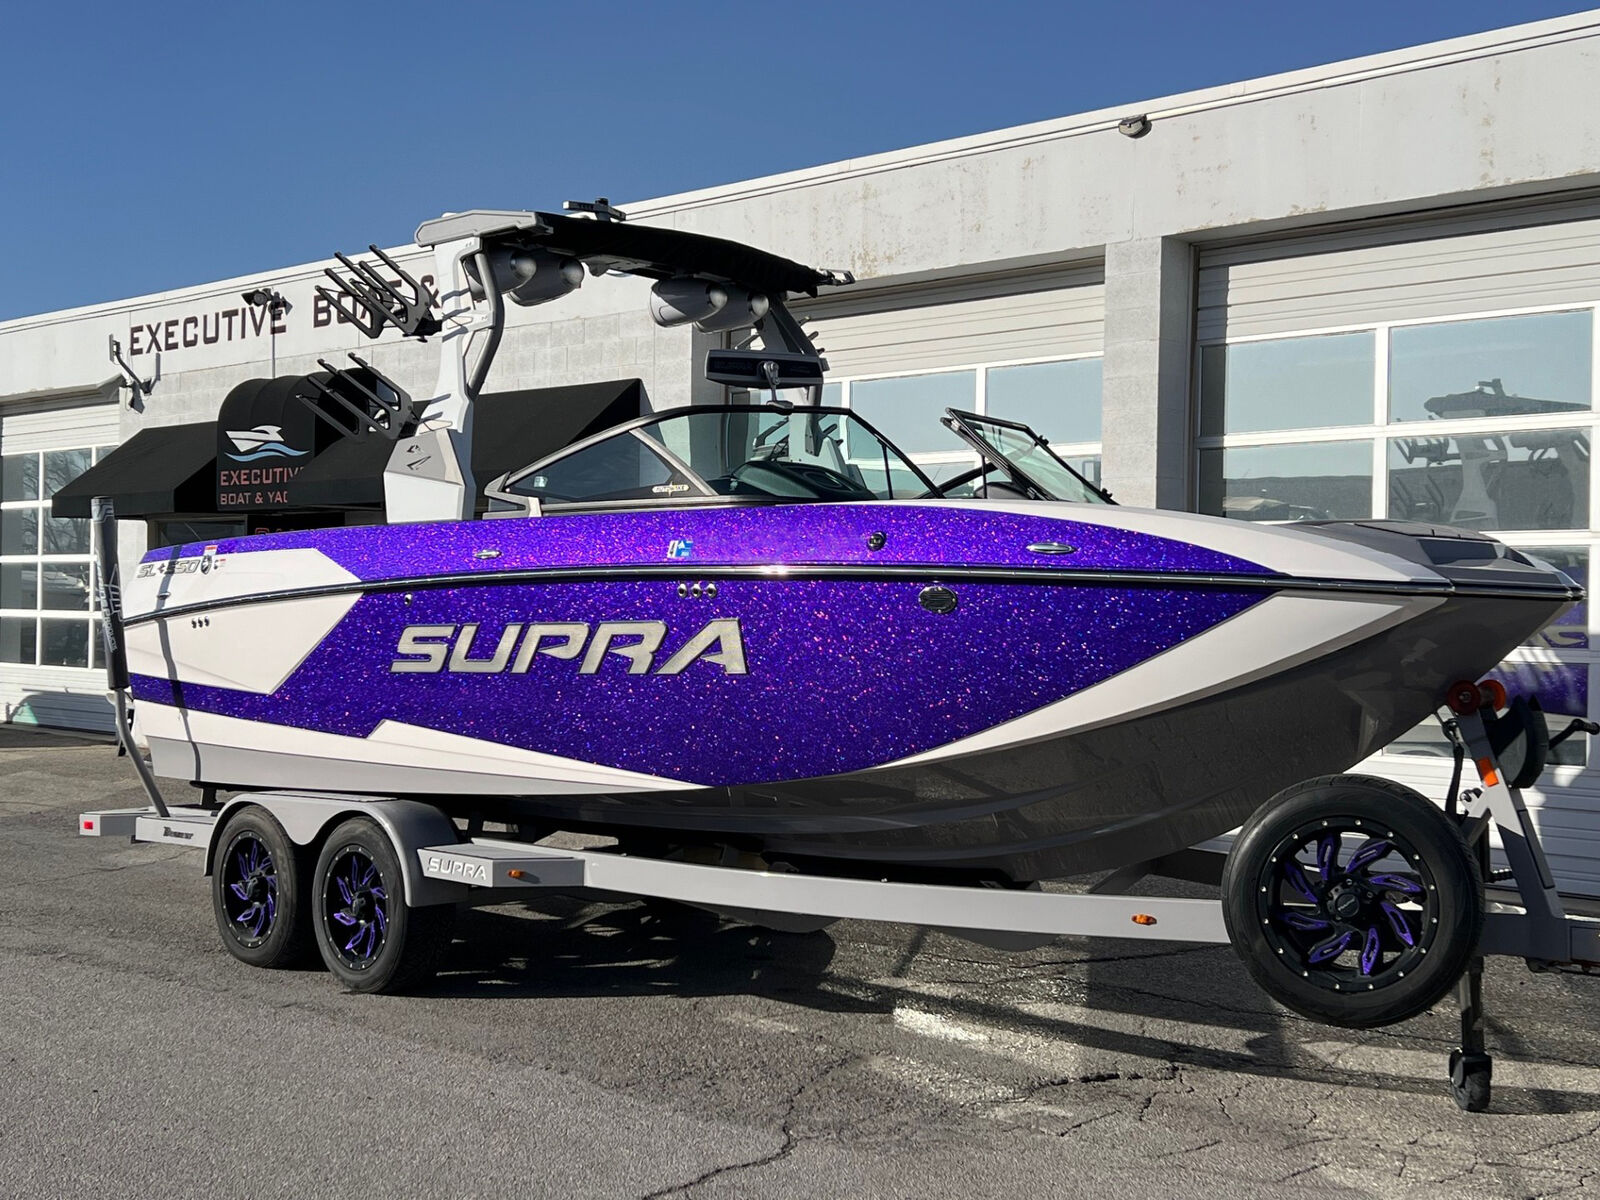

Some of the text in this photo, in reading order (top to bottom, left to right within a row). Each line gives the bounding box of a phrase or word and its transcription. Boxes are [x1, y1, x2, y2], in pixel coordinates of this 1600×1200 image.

[130, 303, 287, 356] EXECUTIVE
[220, 466, 304, 486] EXECUTIV
[220, 492, 251, 505] BOAT
[254, 491, 263, 504] &
[390, 617, 751, 675] SUPRA
[427, 856, 487, 880] SUPRA
